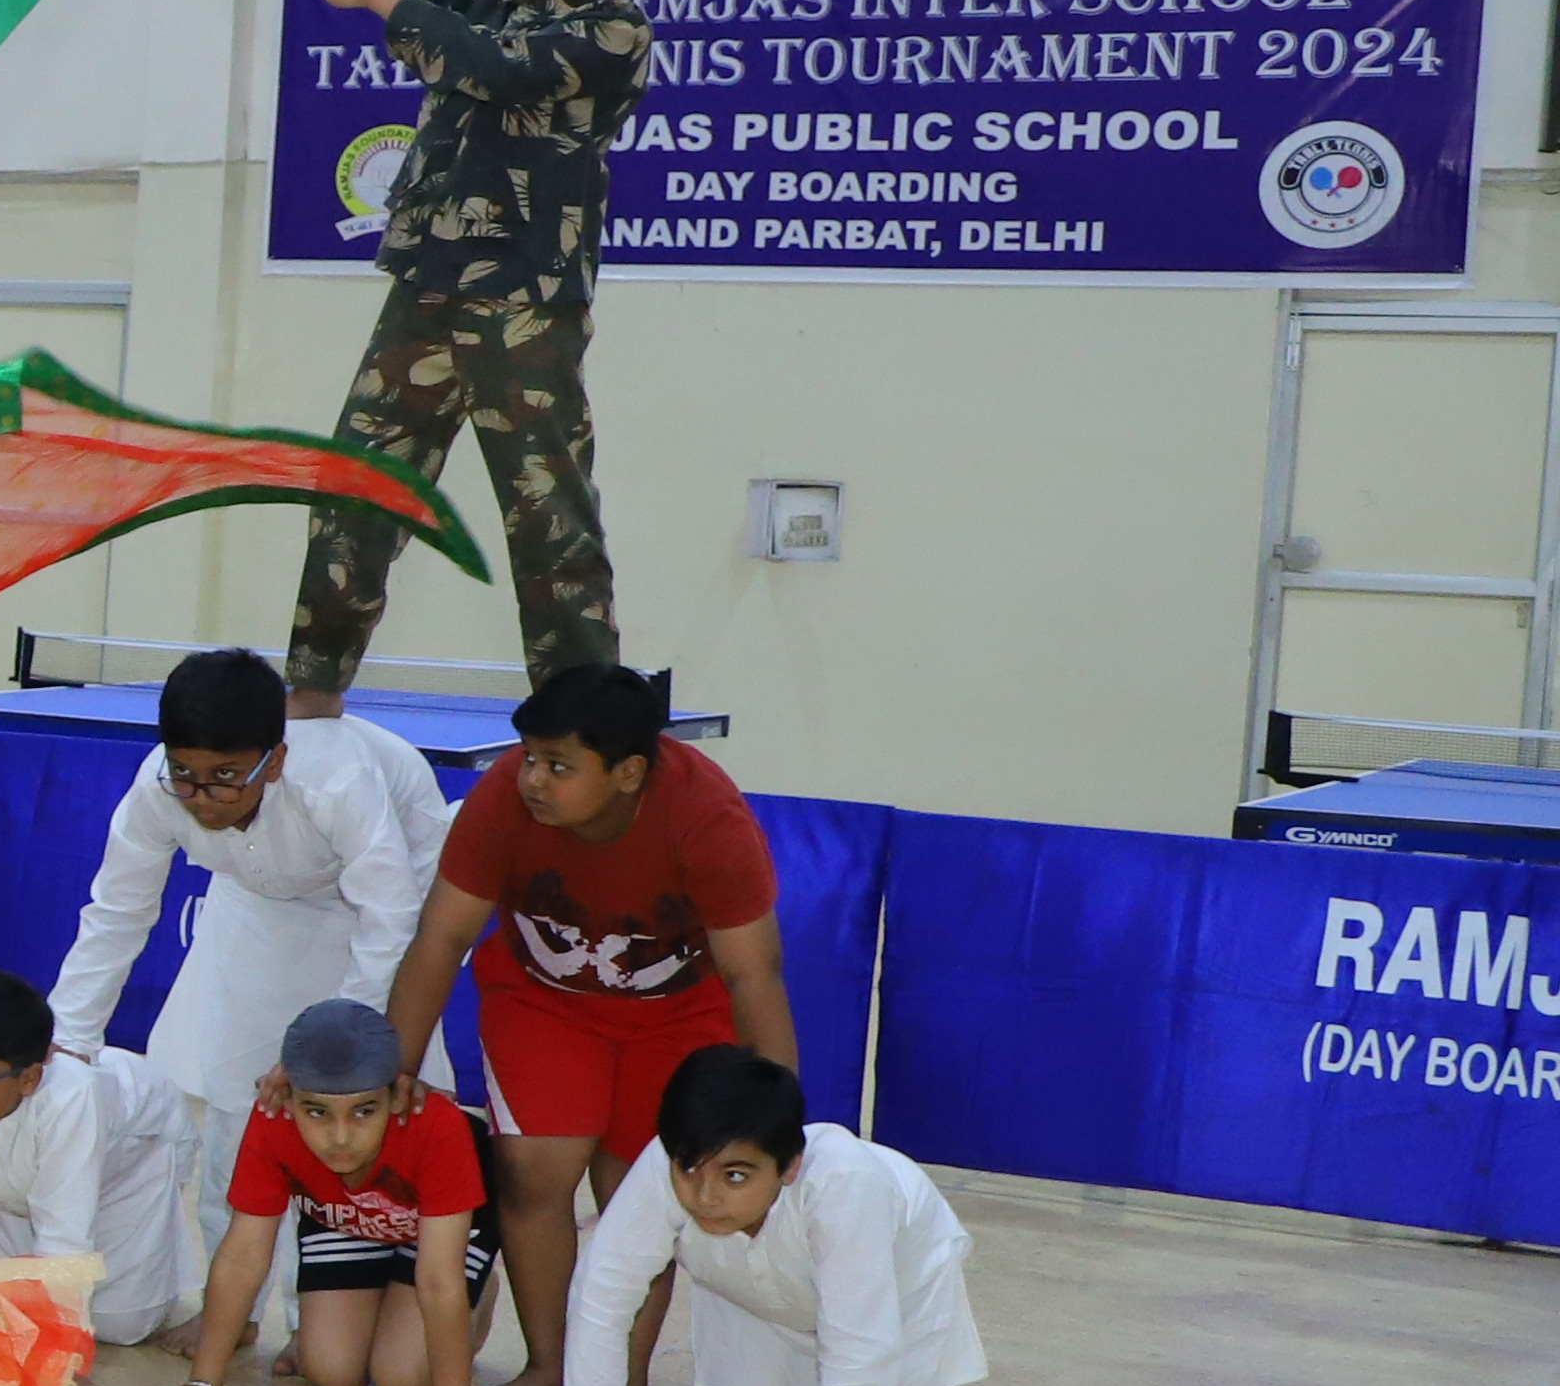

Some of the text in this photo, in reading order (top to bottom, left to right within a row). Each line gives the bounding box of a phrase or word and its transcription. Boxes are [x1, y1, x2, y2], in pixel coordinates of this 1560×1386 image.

[647, 38, 745, 87] NIS
[763, 29, 1234, 86] TOURNAMENT
[1256, 26, 1444, 80] 2024
[609, 110, 1238, 153] JAS PUBLIC SCHOOL
[1288, 143, 1330, 169] TABLE
[666, 171, 1018, 203] DAY BOARDING
[754, 219, 943, 258] PARBAT,
[959, 220, 1104, 252] DELHI
[1285, 826, 1396, 847] GYMNCO
[1301, 1021, 1416, 1082] (DAY
